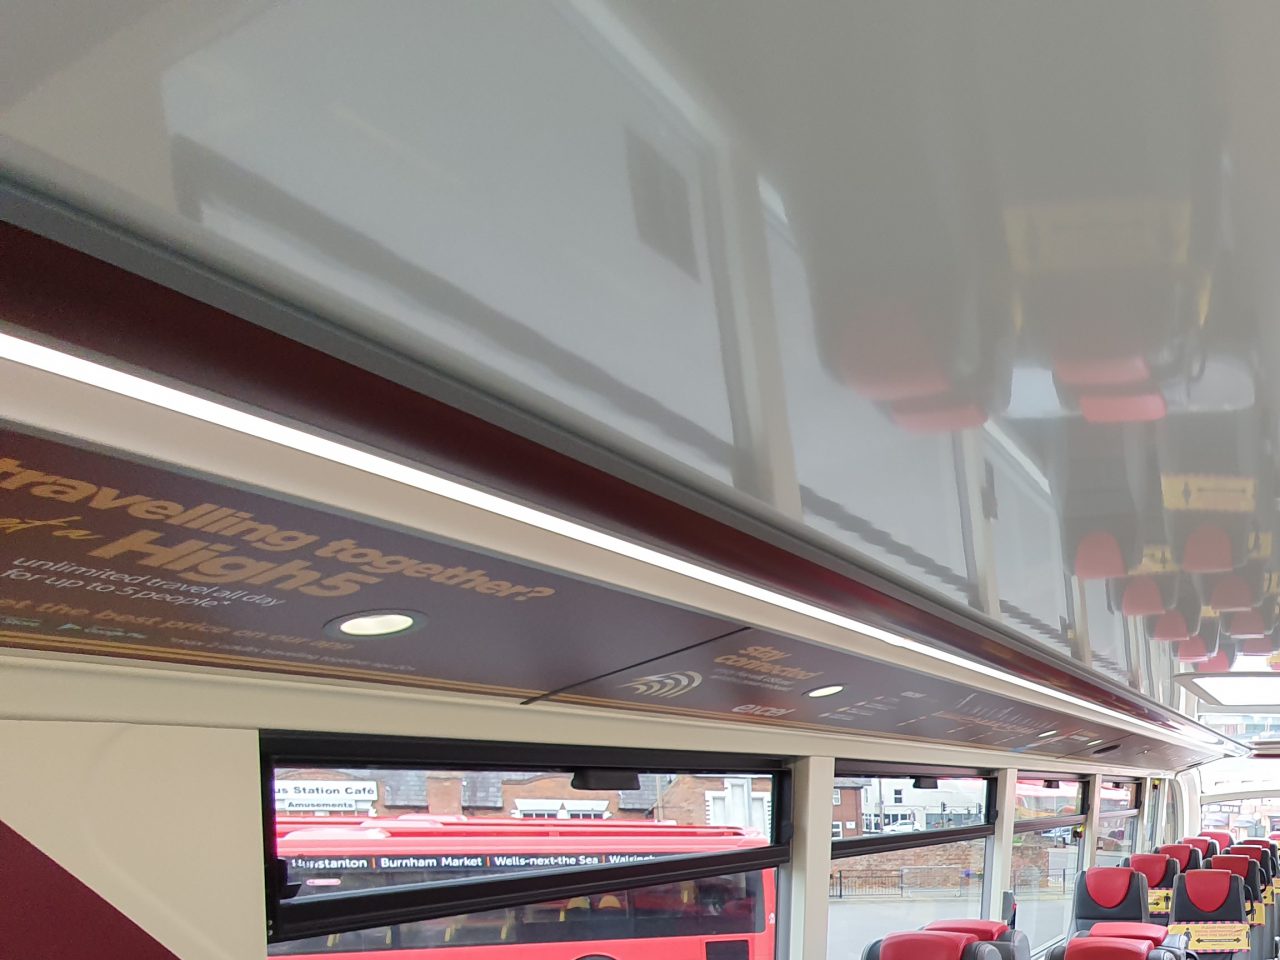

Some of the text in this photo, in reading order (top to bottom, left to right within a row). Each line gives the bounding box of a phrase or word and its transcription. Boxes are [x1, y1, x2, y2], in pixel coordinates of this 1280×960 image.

[0, 457, 556, 601] travelling together?
[87, 529, 384, 598] High5
[0, 568, 43, 581] for
[44, 575, 85, 589] up
[85, 581, 116, 593] to
[115, 585, 134, 595] 5
[12, 556, 287, 607] unlimited travel all day
[92, 608, 163, 626] best
[158, 618, 231, 634] price
[738, 645, 793, 661] stay
[293, 786, 341, 795] Station
[344, 786, 375, 795] Café
[287, 801, 354, 809] Amusements
[380, 856, 437, 869] Burnham
[441, 855, 483, 868] Market
[494, 854, 576, 867] Wells-next-the
[578, 854, 600, 865] Sea
